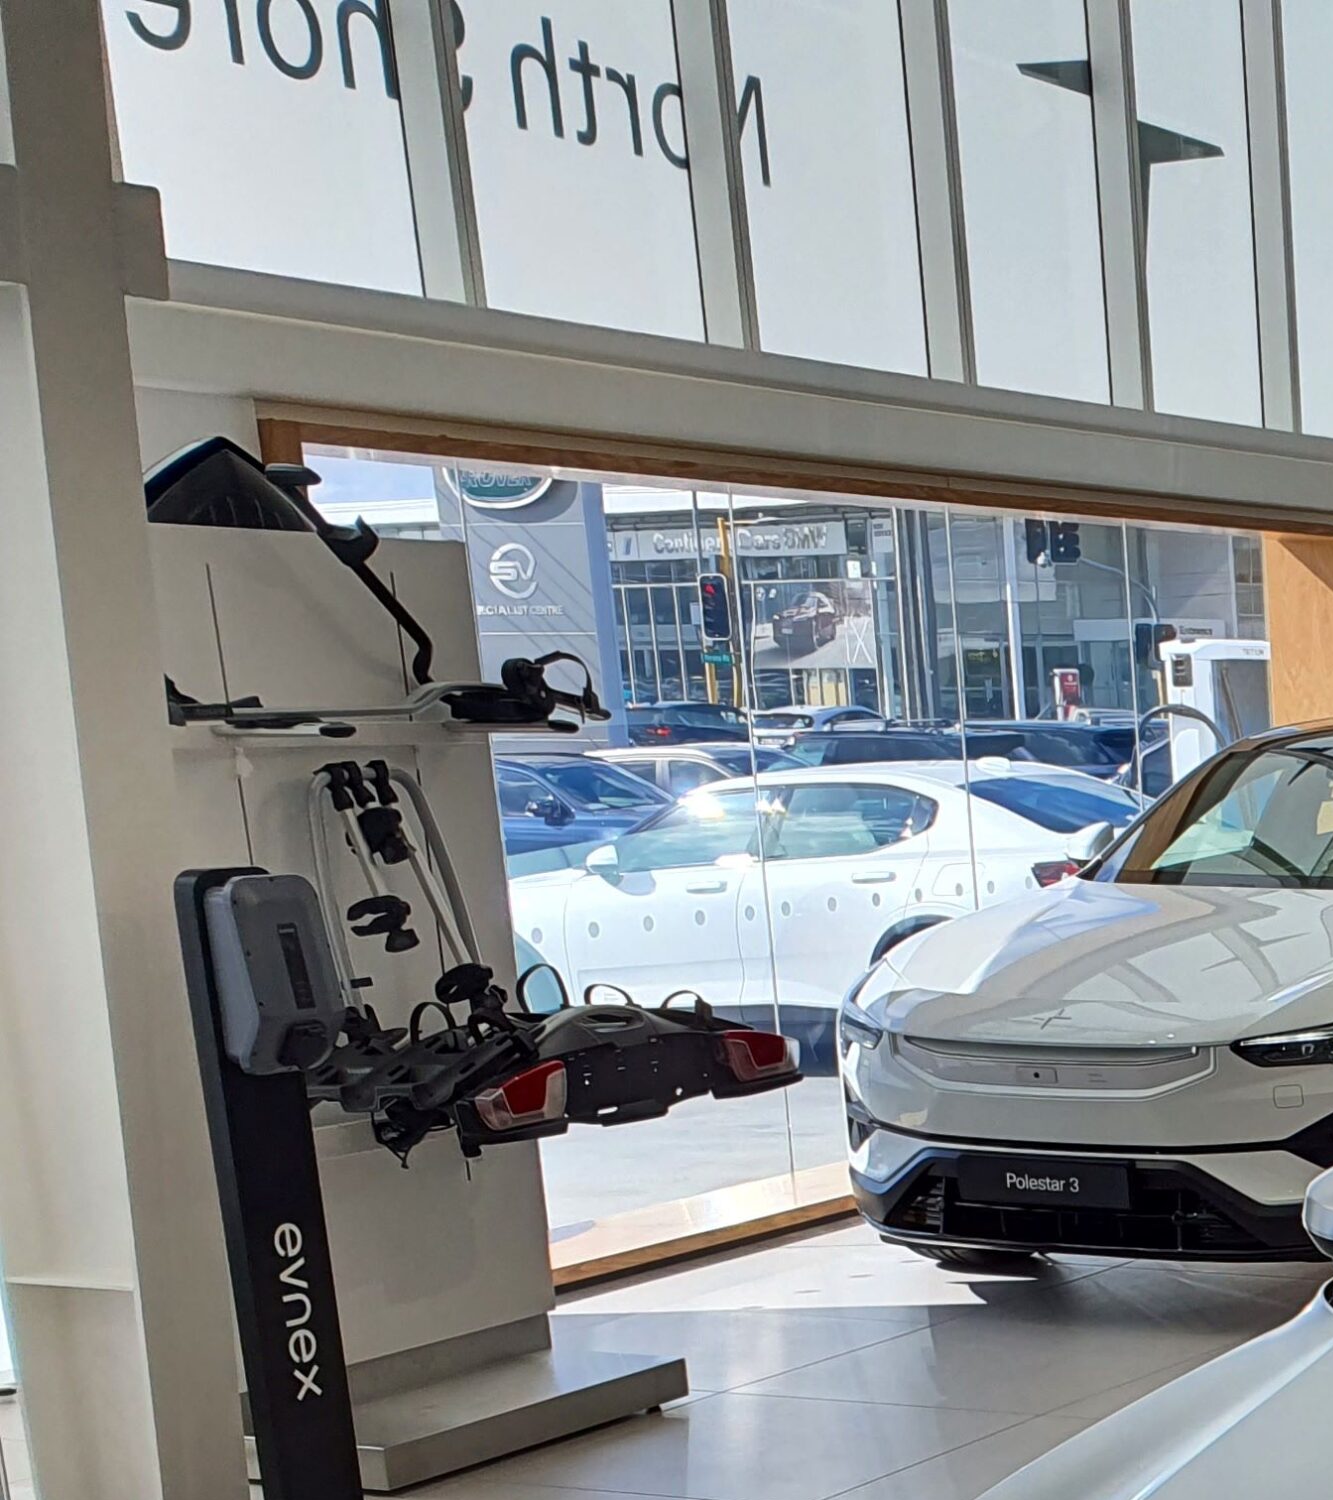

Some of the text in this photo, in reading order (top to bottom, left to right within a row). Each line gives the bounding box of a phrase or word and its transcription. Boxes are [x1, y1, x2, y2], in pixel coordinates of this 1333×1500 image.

[737, 528, 781, 550] Cars
[1006, 1172, 1080, 1193] Polestar 3
[273, 1222, 322, 1401] evnex
